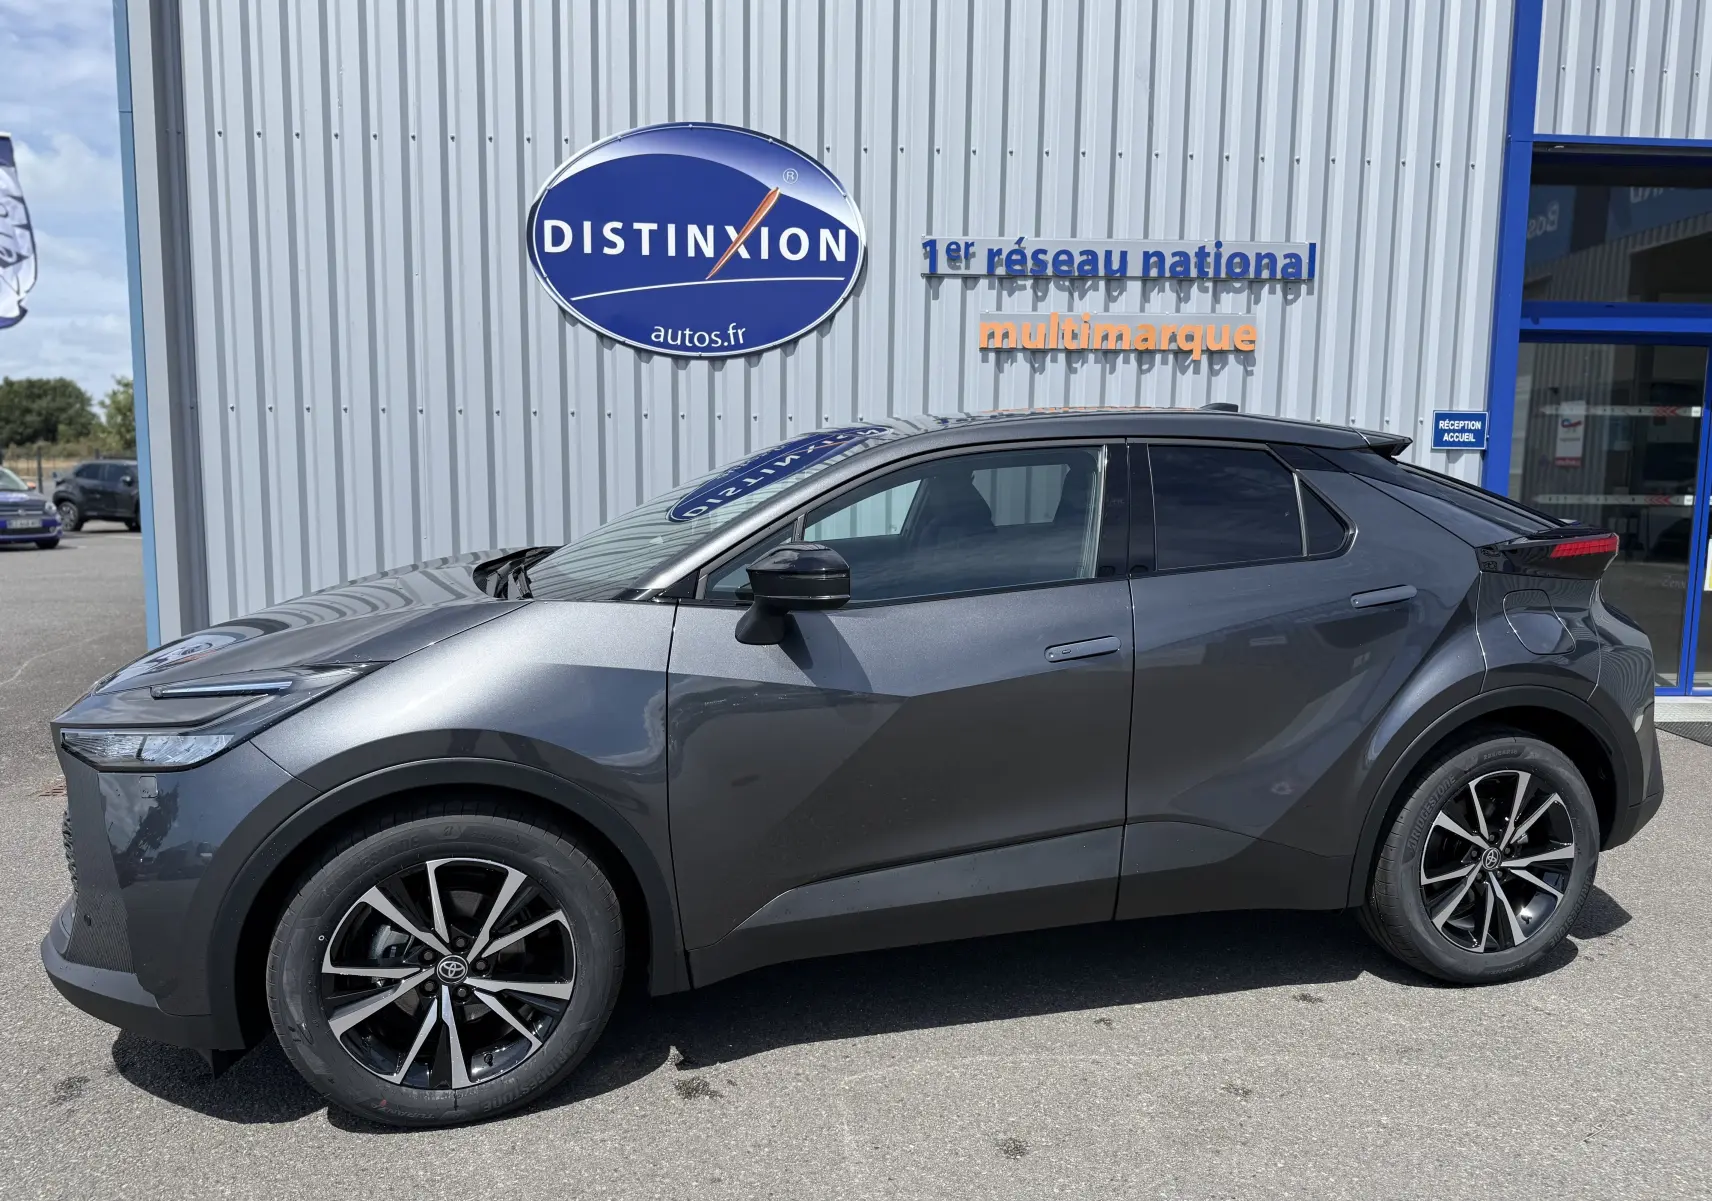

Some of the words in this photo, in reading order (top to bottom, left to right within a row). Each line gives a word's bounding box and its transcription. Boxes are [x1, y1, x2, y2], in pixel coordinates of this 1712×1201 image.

[543, 211, 847, 265] DISTINXION
[922, 238, 976, 274] 1er
[986, 236, 1128, 277] réseau
[1142, 240, 1317, 280] national
[651, 322, 746, 348] autos.fr
[979, 312, 1257, 361] multimarque
[1438, 418, 1482, 430] RÉCEPTION
[1442, 432, 1476, 442] ACCUEIL
